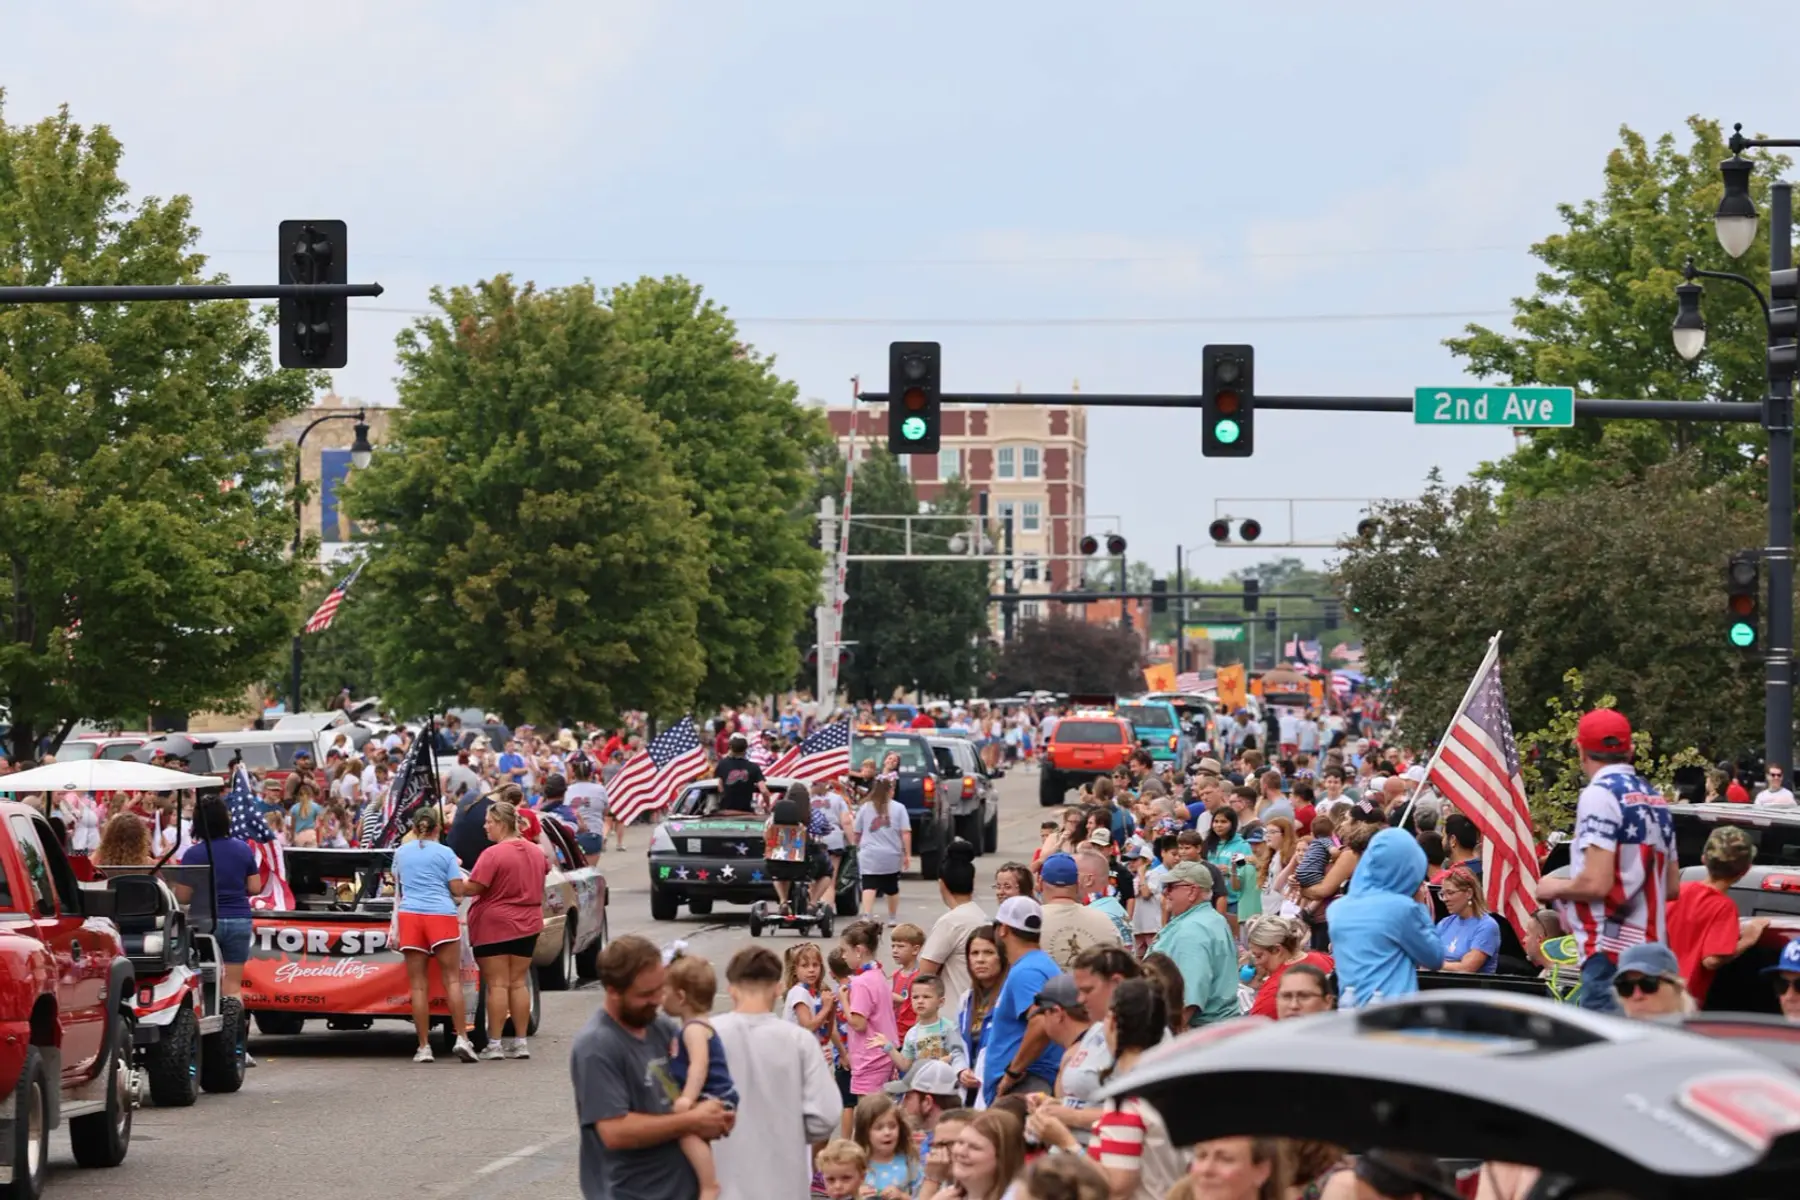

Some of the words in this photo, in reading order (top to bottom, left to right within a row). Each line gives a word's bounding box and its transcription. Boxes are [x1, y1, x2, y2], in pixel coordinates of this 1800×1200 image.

[1434, 392, 1488, 420] 2nd
[1502, 392, 1554, 420] Ave
[250, 927, 330, 953] TOR
[275, 957, 380, 983] Specialties
[274, 995, 290, 1003] KS
[294, 995, 326, 1005] 67501
